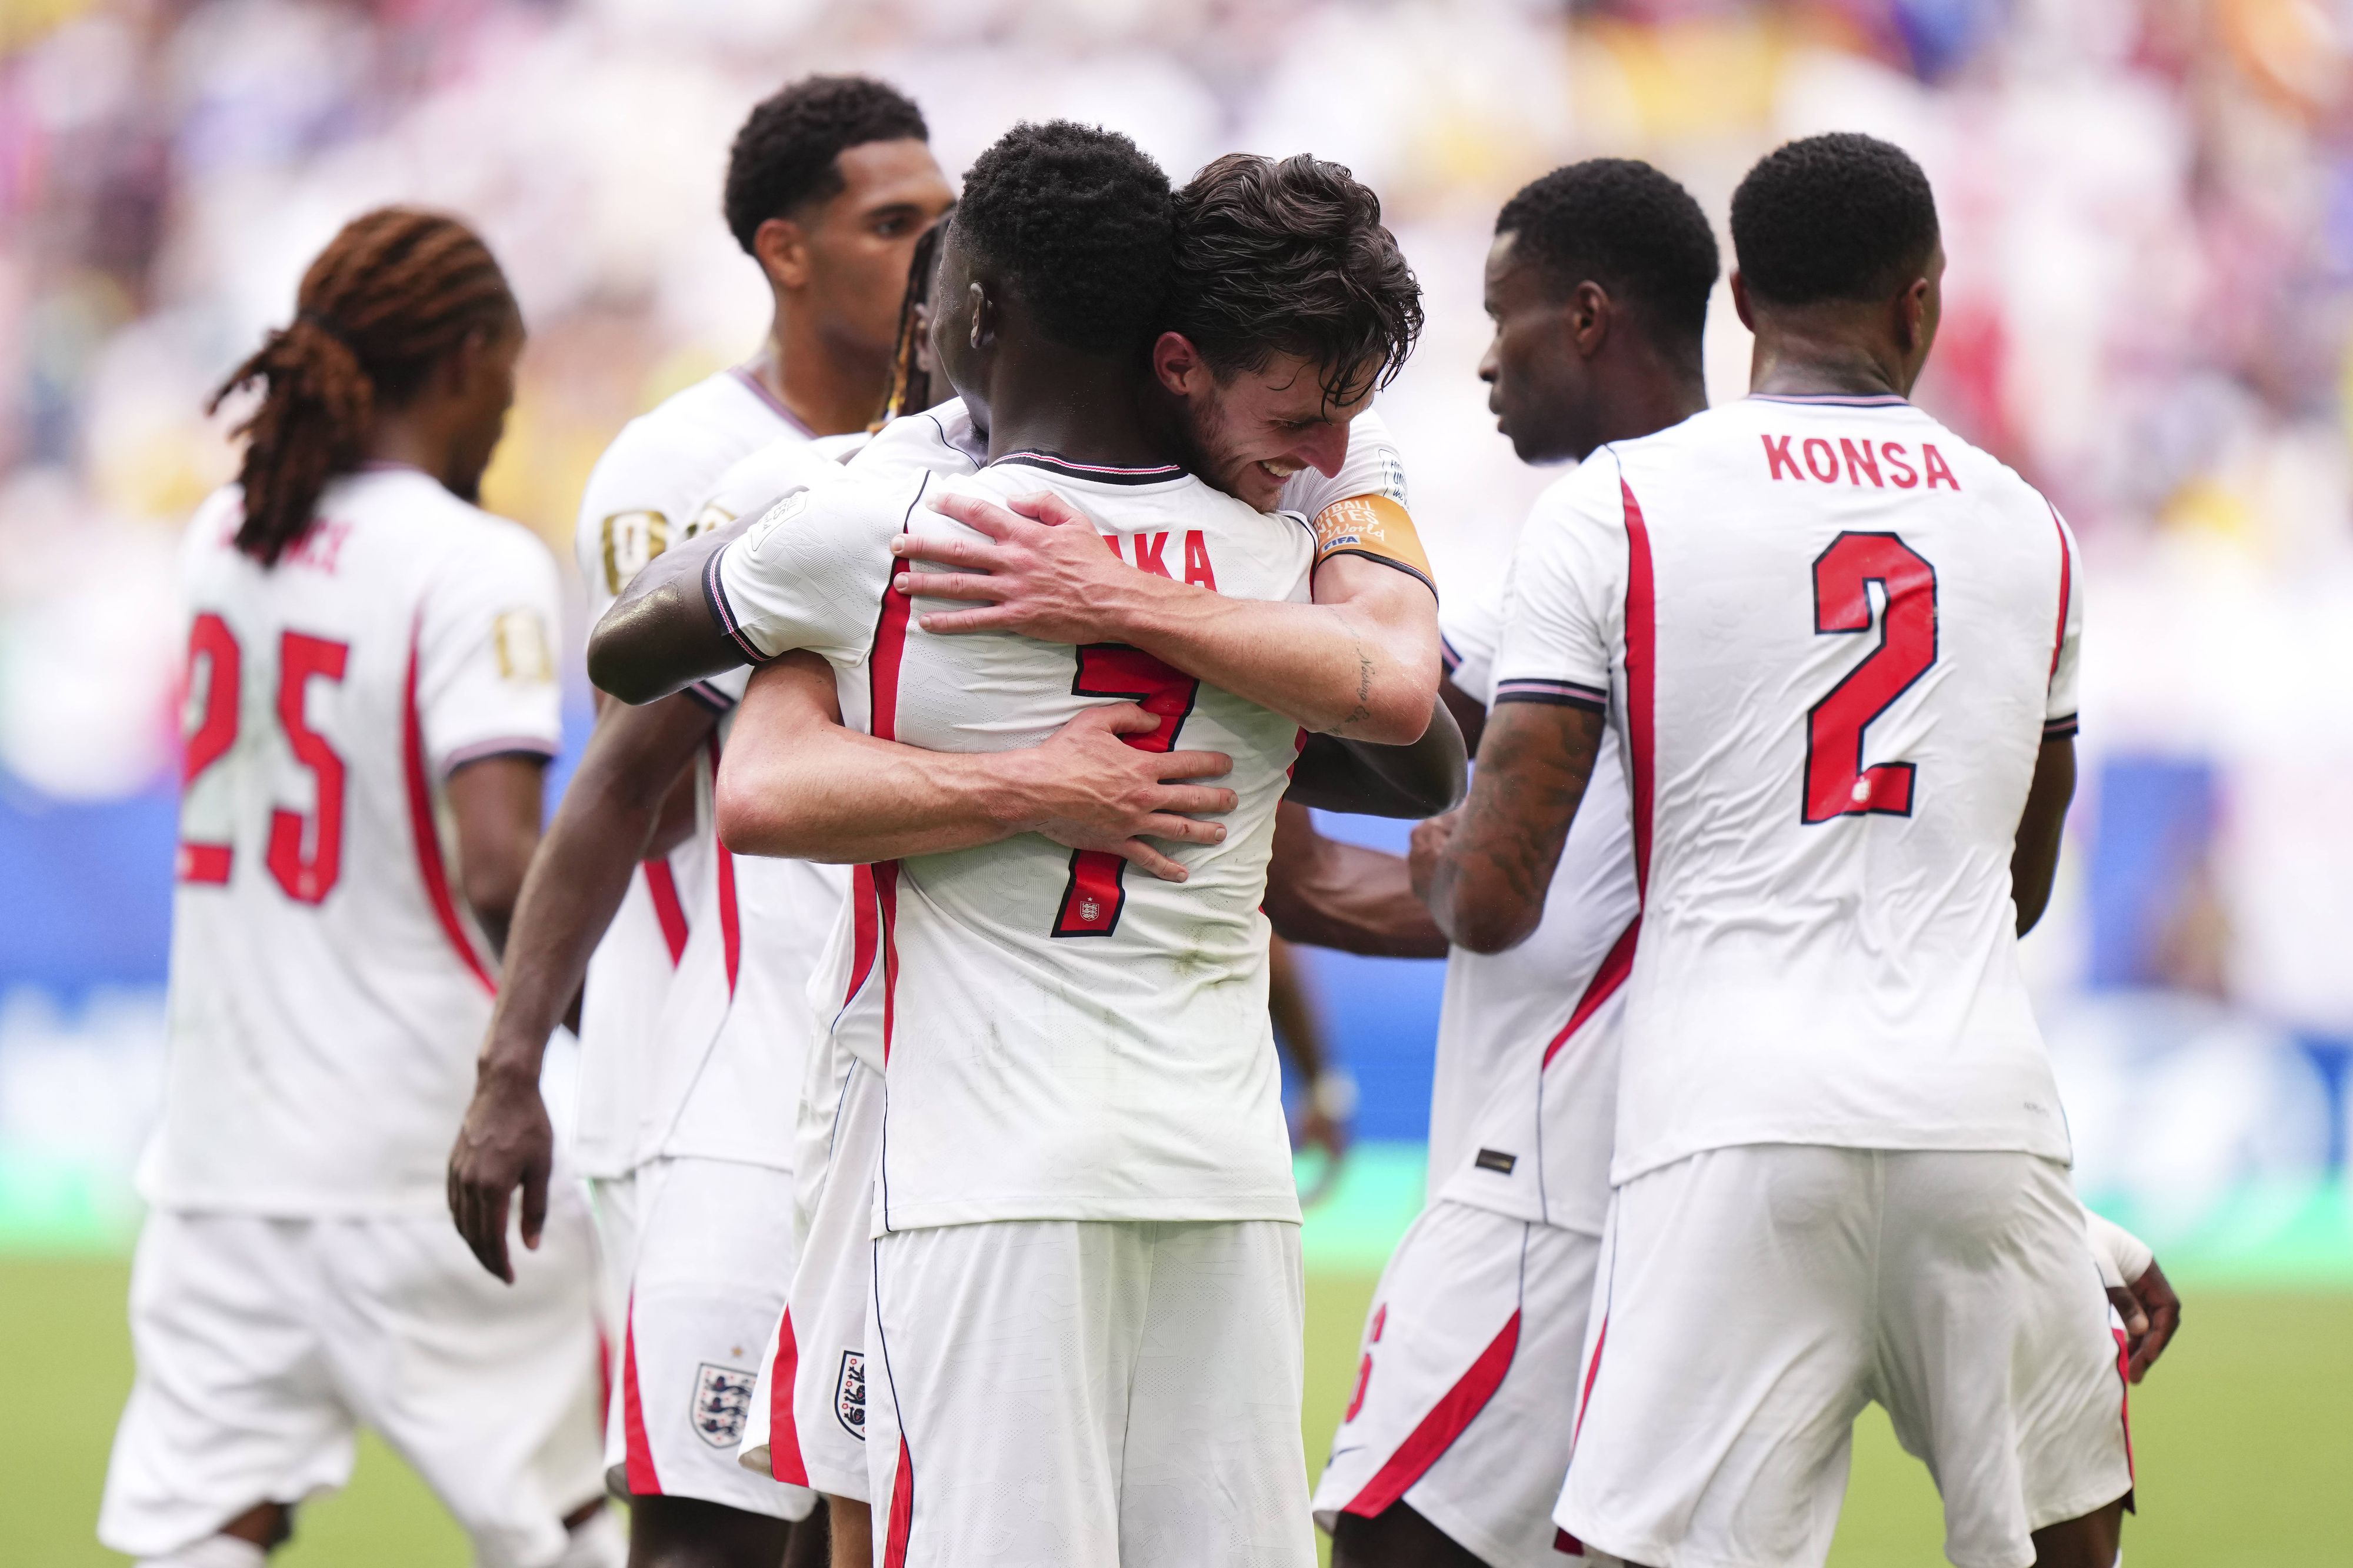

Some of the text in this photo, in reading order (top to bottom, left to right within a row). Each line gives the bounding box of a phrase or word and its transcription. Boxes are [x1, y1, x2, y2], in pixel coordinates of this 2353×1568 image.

[1761, 433, 1961, 492] KONSA
[1317, 510, 1379, 535] NITES
[1324, 536, 1358, 551] FIFA
[1102, 530, 1217, 592] KA
[1801, 531, 1939, 825] 2
[175, 610, 349, 905] 25
[1051, 643, 1200, 938] 7
